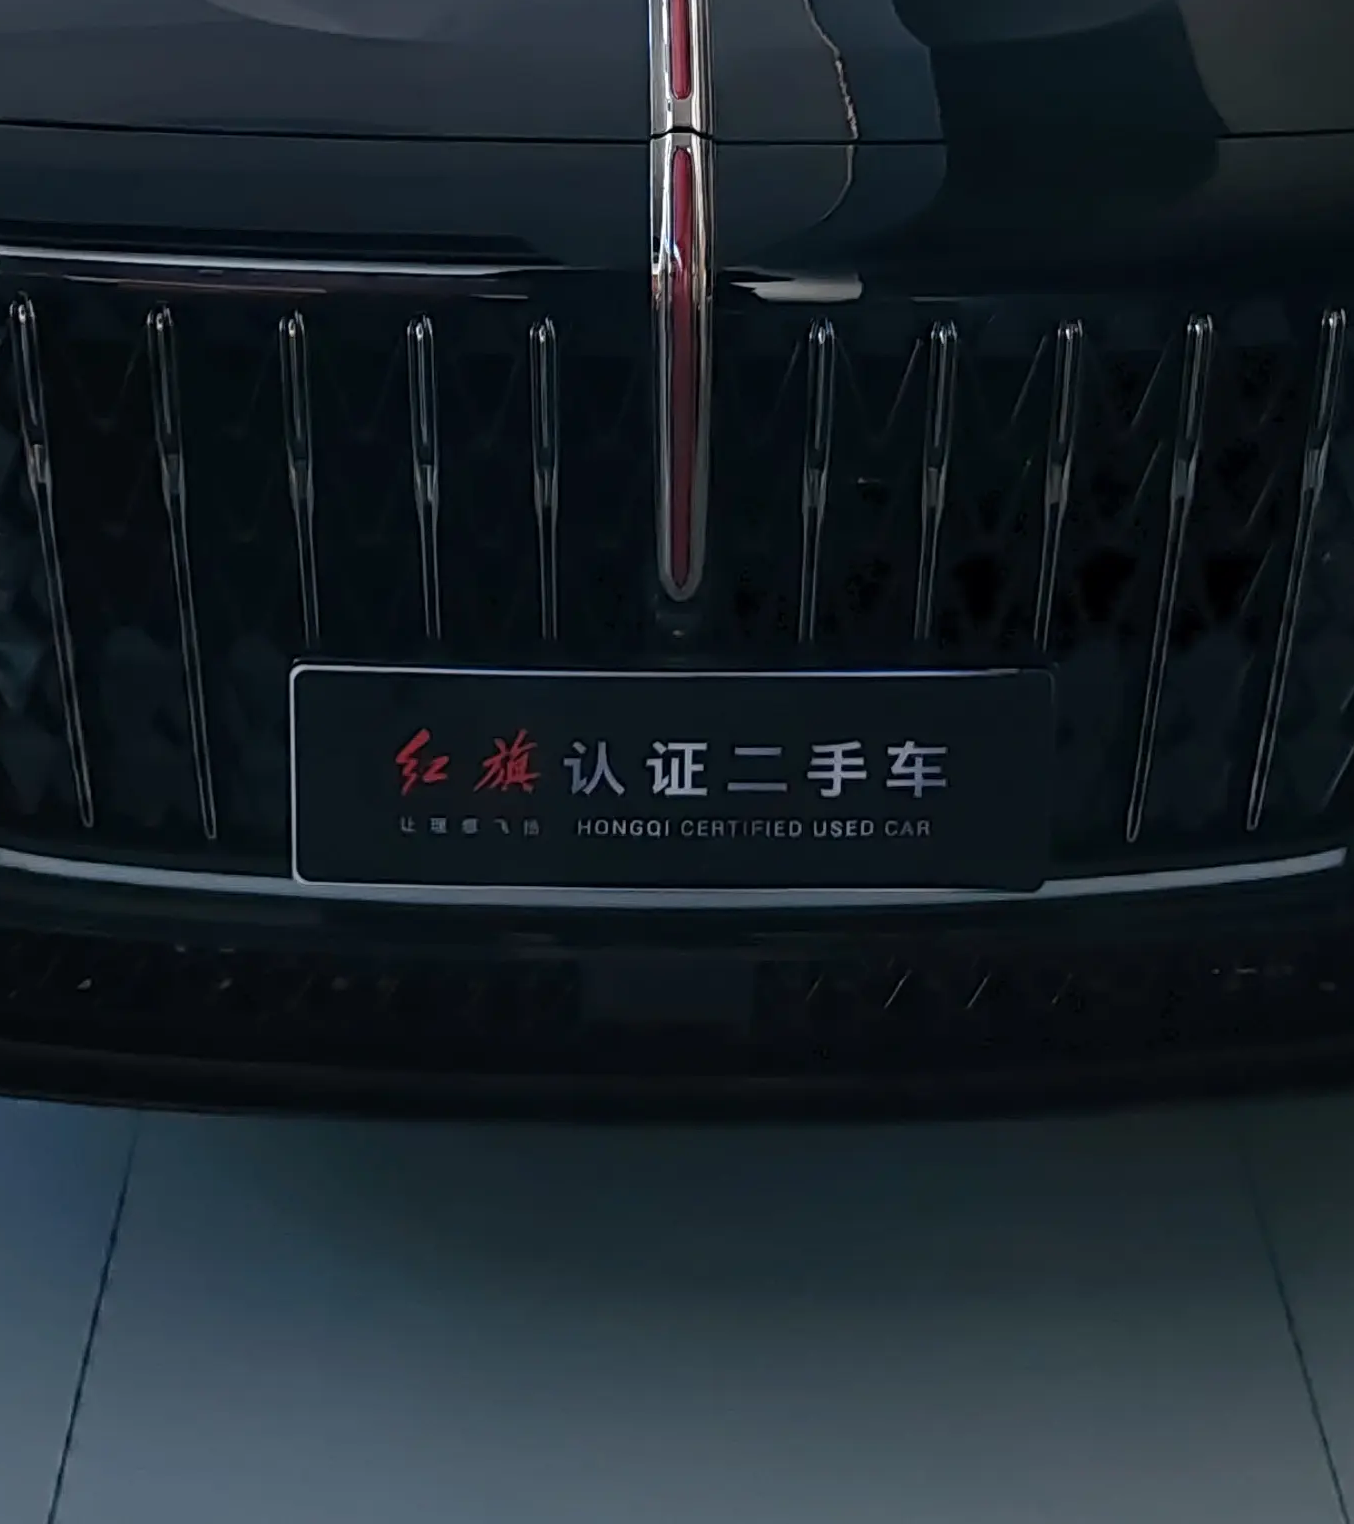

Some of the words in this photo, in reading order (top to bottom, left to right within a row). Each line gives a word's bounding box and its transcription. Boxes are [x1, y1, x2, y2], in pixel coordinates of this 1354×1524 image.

[393, 727, 542, 797] 红旗
[563, 739, 948, 799] 认证二手车
[576, 818, 671, 839] HONGQI
[679, 818, 804, 839] CERTIFIED
[812, 818, 875, 838] USED
[883, 818, 932, 837] CAR
